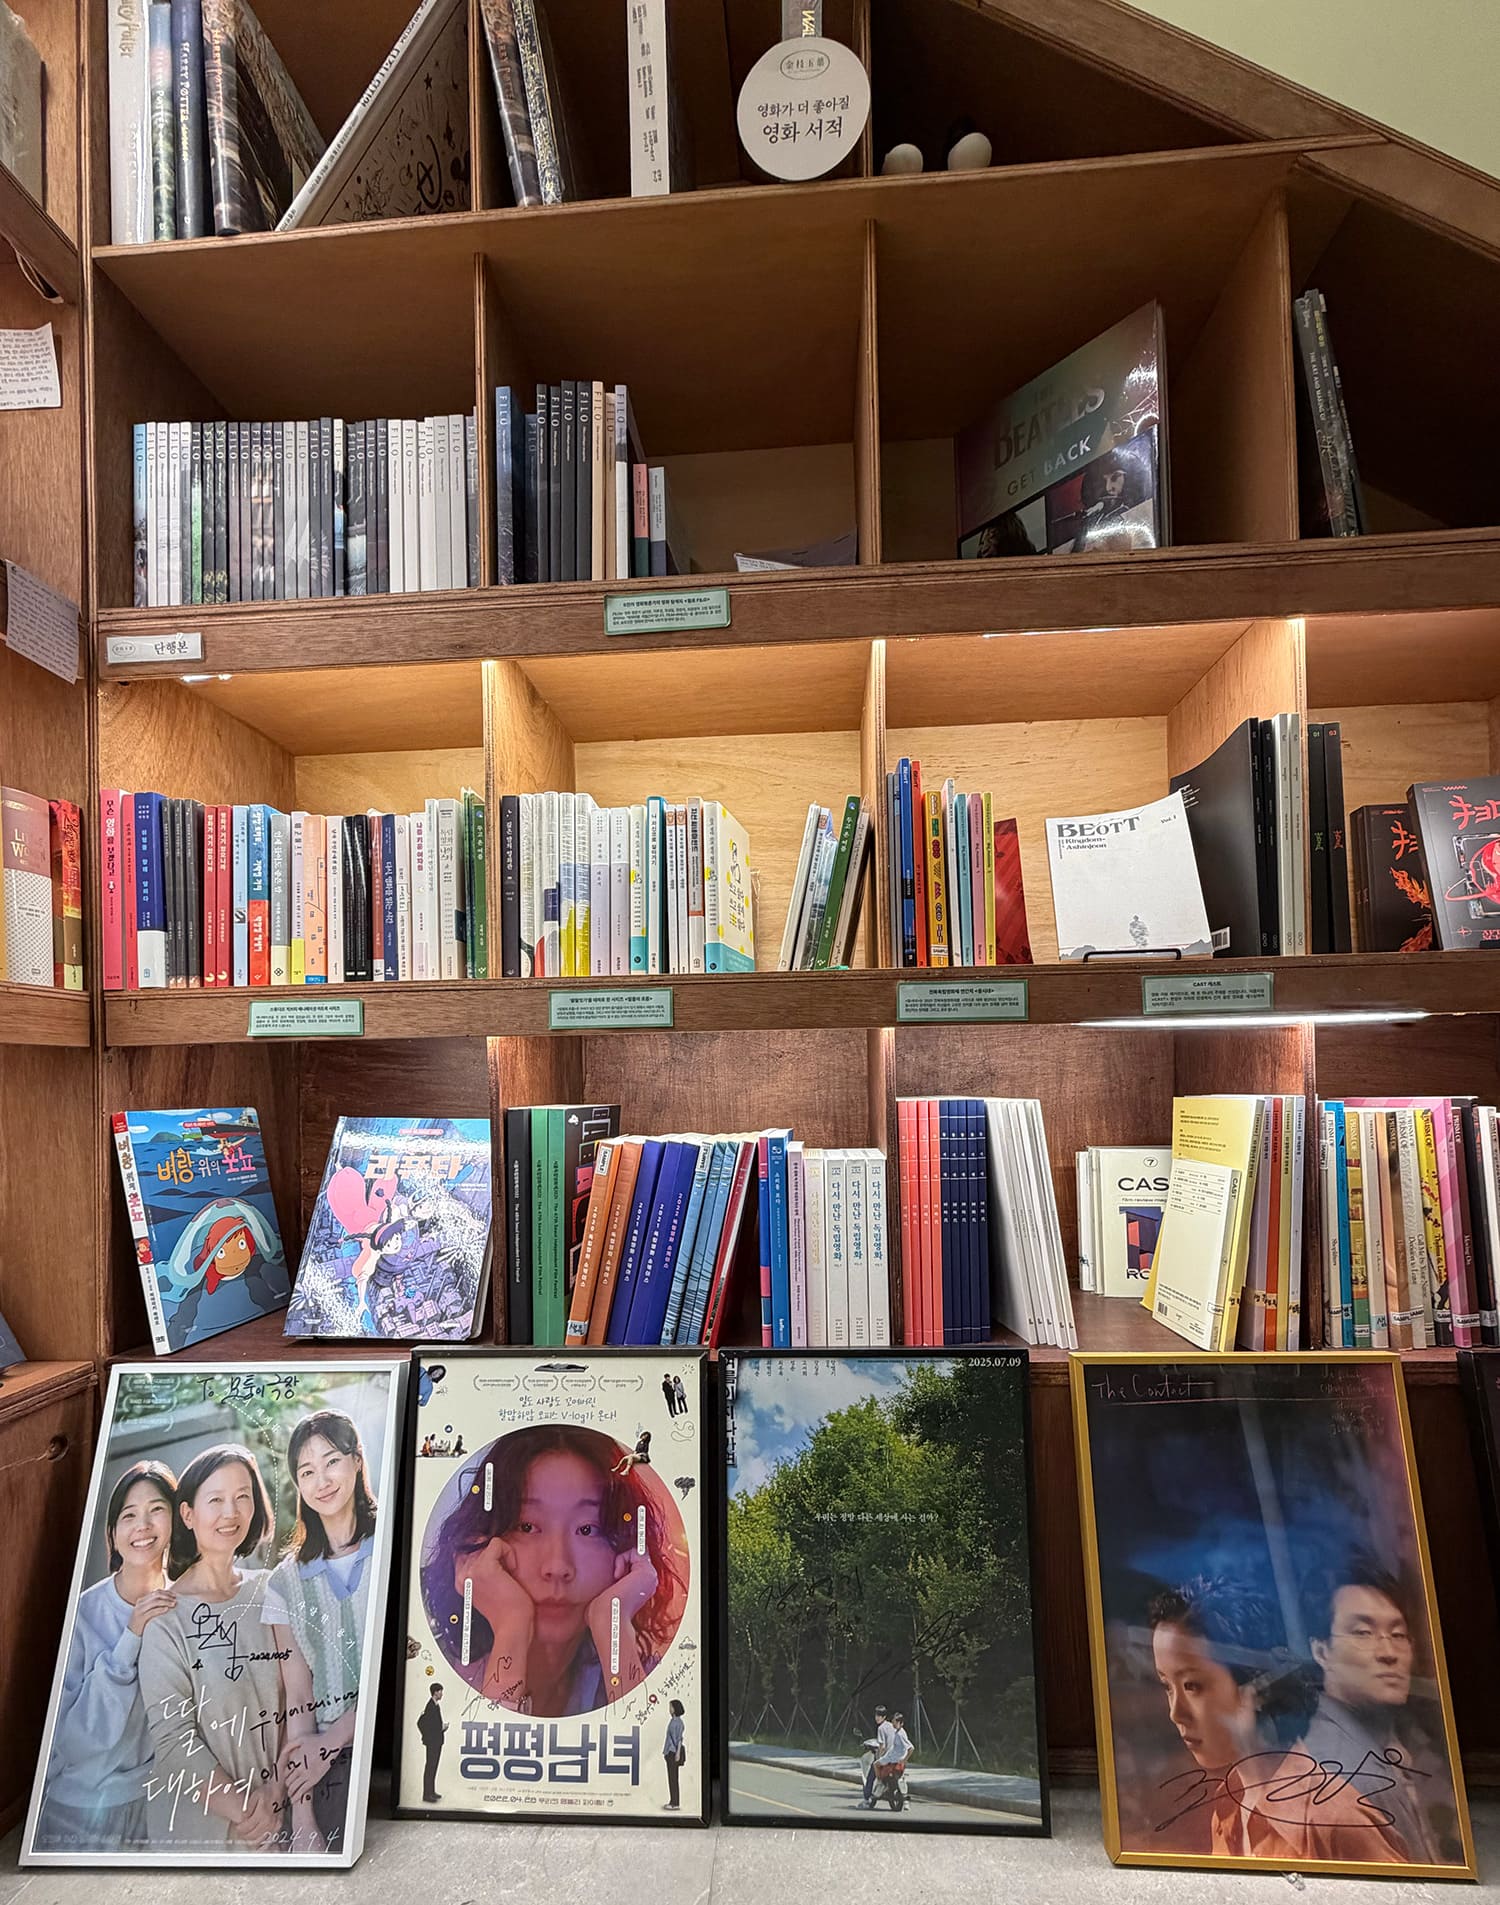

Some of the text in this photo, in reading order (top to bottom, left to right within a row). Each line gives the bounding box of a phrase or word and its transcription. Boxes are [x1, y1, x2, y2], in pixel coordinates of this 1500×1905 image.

[212, 29, 223, 68] HARRY
[180, 41, 190, 122] HARRY POTTER
[757, 95, 850, 118] 영화가 더 좋아질
[762, 116, 843, 144] 영화 서적
[551, 396, 560, 427] FILO
[594, 390, 602, 422] FILO
[136, 433, 144, 462] FILO
[170, 430, 178, 460] FILO
[204, 431, 212, 460] FILO
[240, 430, 249, 460] FILO
[274, 430, 282, 460] FILO
[310, 429, 319, 459] FILO
[348, 432, 356, 462] FILO
[378, 426, 387, 457] FILO
[418, 430, 426, 460] FILO
[452, 422, 460, 453] FILO
[1007, 435, 1092, 496] GET BACK
[154, 640, 188, 655] 단행본
[106, 799, 115, 876] 무슨 영화를 보겠다고
[273, 830, 283, 845] 언제
[385, 876, 394, 896] 영화를
[386, 896, 394, 910] 읽는
[386, 911, 394, 924] 시간
[1398, 1117, 1406, 1139] PRISM
[157, 1146, 257, 1185] 벼랑 위의 포뇨
[364, 1154, 464, 1180] 라퓨타
[599, 1151, 608, 1171] SAMPLE
[118, 1136, 132, 1170] 벼랑
[128, 1192, 144, 1223] 포뇨
[1118, 1177, 1170, 1192] CAS
[1231, 1177, 1239, 1200] CAST
[613, 1204, 621, 1229] 2020
[635, 1202, 643, 1227] 2021
[656, 1203, 664, 1228] 2021
[674, 1193, 683, 1216] 2022
[590, 1206, 598, 1231] 2020
[831, 1181, 842, 1261] 다시 만난 독립영화
[851, 1180, 863, 1260] 다시 만난 독립영화
[871, 1181, 883, 1261] 다시 만난 독립영화
[1434, 1233, 1442, 1256] Thelma
[1463, 1234, 1471, 1255] Moving
[1419, 1264, 1427, 1280] Your
[967, 1357, 1022, 1368] 2025.07.09
[1091, 1373, 1127, 1399] The
[519, 1396, 596, 1408] 일도 사랑도 꼬여버린
[538, 1410, 558, 1421] 오피스
[560, 1409, 594, 1424] V-log가
[814, 1512, 838, 1522] 우리는
[839, 1513, 855, 1522] 정말
[857, 1513, 873, 1522] 다른
[874, 1513, 899, 1522] 세상에
[900, 1513, 916, 1522] 사는
[160, 1685, 247, 1758] 딸에
[460, 1720, 641, 1786] 평평남녀
[142, 1768, 254, 1832] 대하여
[262, 1828, 302, 1853] 2024
